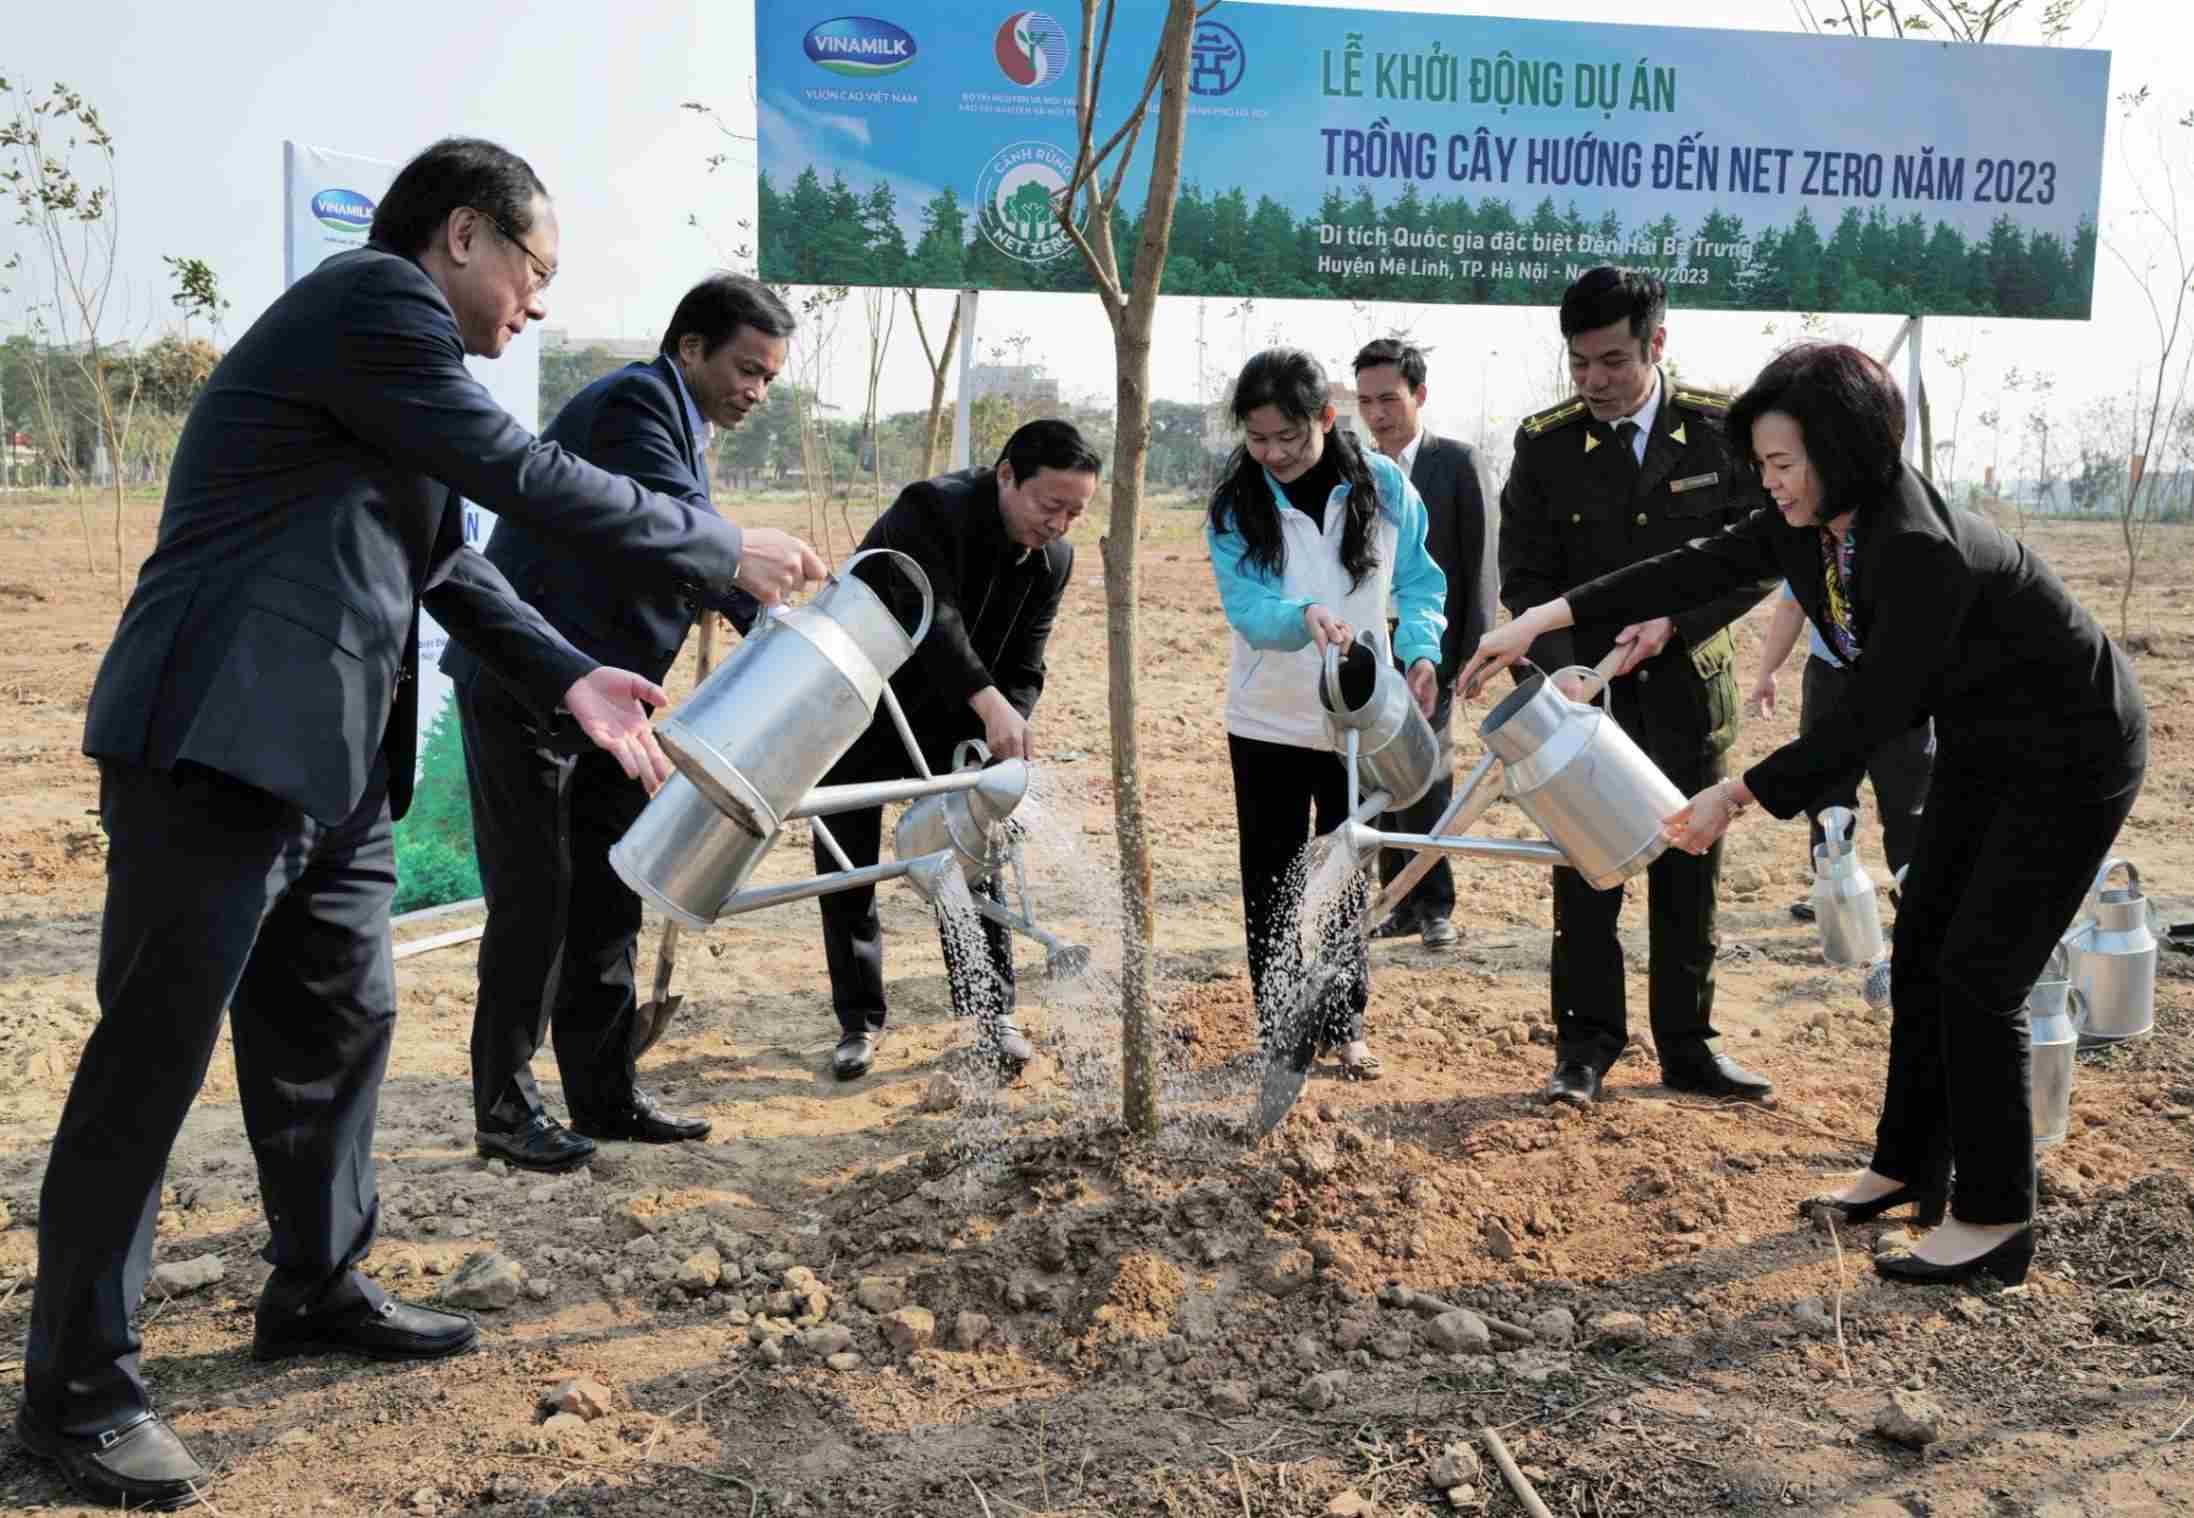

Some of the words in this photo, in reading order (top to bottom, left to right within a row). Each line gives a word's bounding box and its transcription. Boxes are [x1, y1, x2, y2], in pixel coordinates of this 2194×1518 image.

[815, 35, 908, 56] VINAMILK
[1322, 32, 1364, 97] LỄ
[1375, 41, 1458, 103] KHỞI
[1469, 50, 1564, 115] ĐỘNG
[1574, 62, 1622, 119] DỰ
[1628, 57, 1676, 112] ÁN
[1321, 116, 1438, 180] TRỒNG
[1448, 126, 1518, 183] CÂY
[1526, 131, 1643, 189] HƯỚNG
[1651, 131, 1719, 192] ĐẾN
[1728, 146, 1794, 194] NET
[1800, 150, 1883, 198] ZERO
[1892, 145, 1965, 201] NĂM
[1973, 158, 2057, 205] 2023
[319, 200, 374, 217] VINAMILK
[993, 227, 1026, 253] NET
[1319, 224, 1342, 246] Di
[1348, 225, 1388, 246] tích
[1394, 226, 1449, 249] Quốc
[1452, 231, 1485, 254] gia
[1490, 232, 1527, 256] đặc
[1532, 232, 1573, 257] biệt
[1625, 236, 1657, 255] Hai
[1317, 255, 1375, 278] Huyện
[1379, 257, 1408, 276] Mê
[1411, 258, 1454, 280] Linh,
[1459, 260, 1486, 279] TP.
[1491, 260, 1514, 280] Hà
[1519, 262, 1548, 285] Nội
